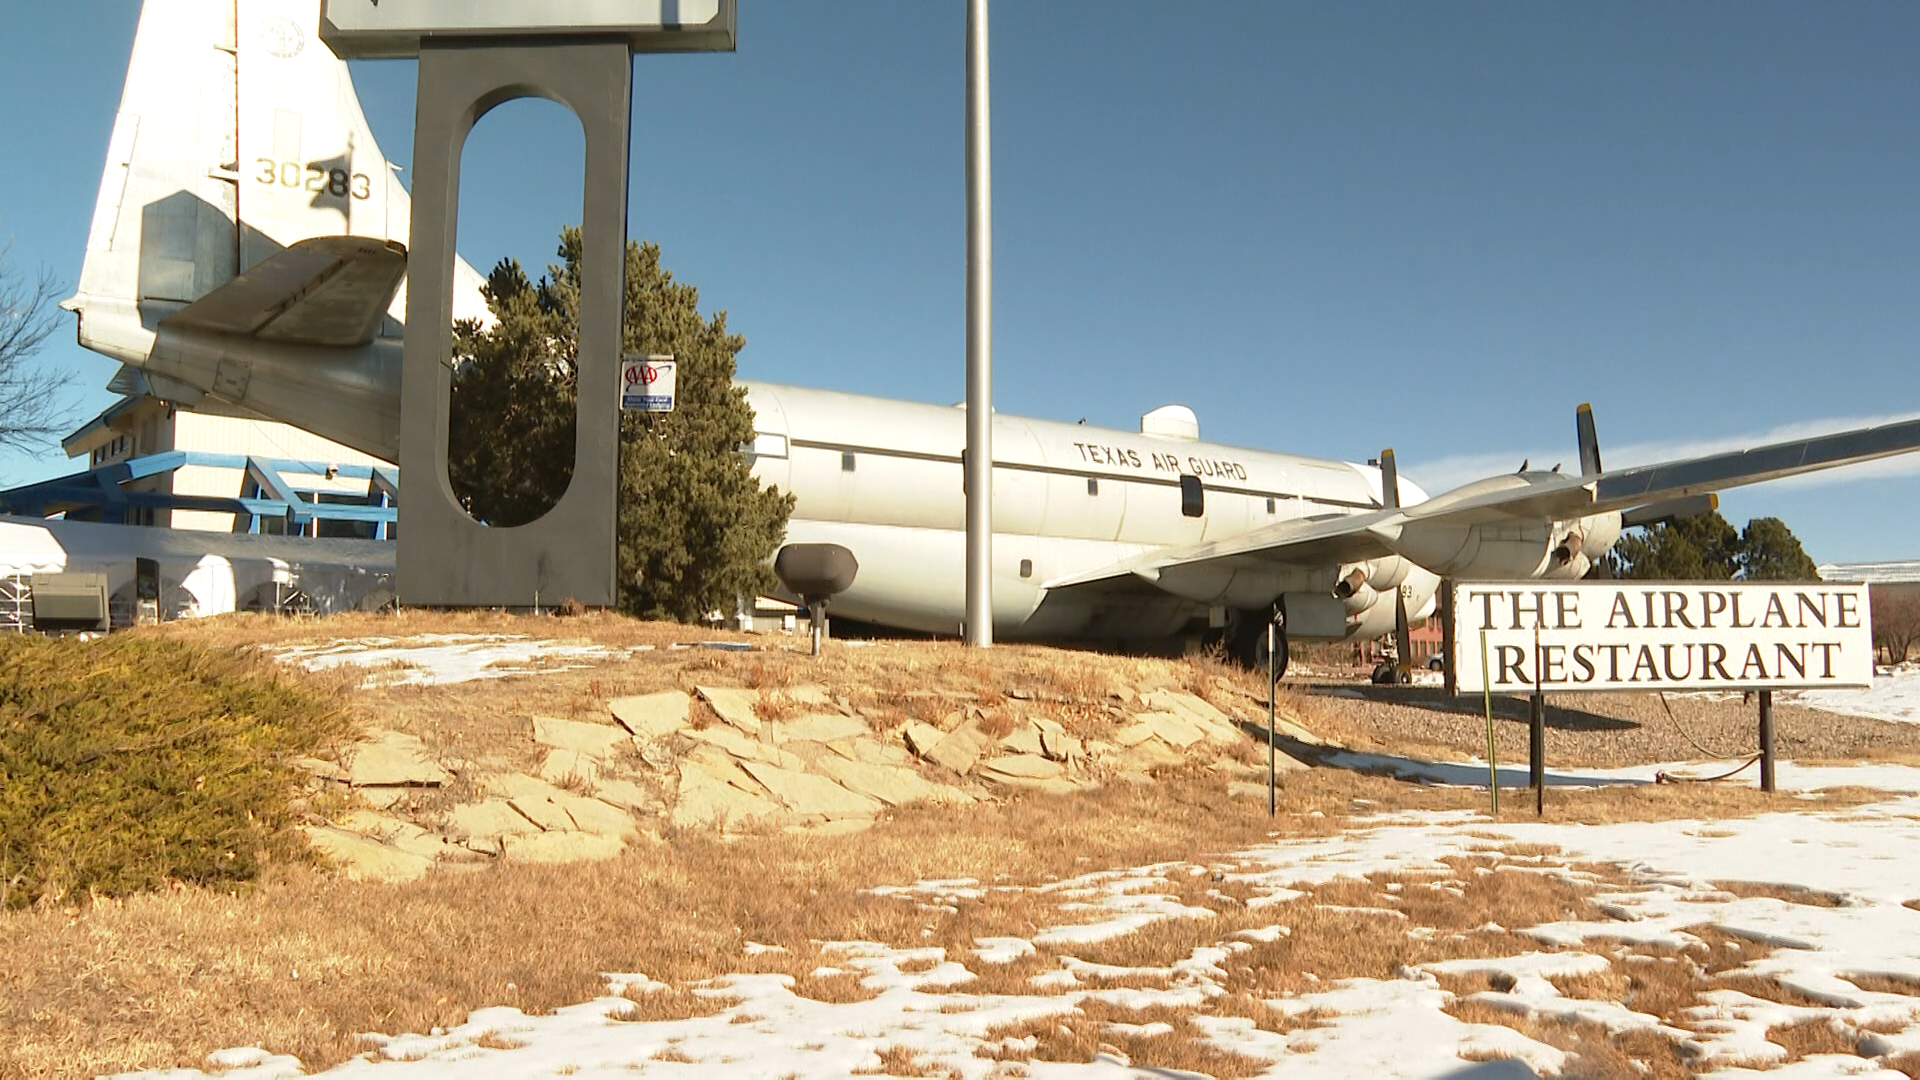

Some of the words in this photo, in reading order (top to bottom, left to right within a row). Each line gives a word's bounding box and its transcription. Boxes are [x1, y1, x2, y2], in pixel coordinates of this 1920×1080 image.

[255, 157, 371, 201] 30283
[625, 364, 658, 386] AAA
[1073, 442, 1142, 468] TEXAS
[1151, 453, 1182, 473] AIR
[1188, 456, 1248, 481] GUARD
[1469, 590, 1583, 631] THE
[1604, 590, 1861, 630] AIRPLANE
[1494, 641, 1842, 685] RESTAURANT
